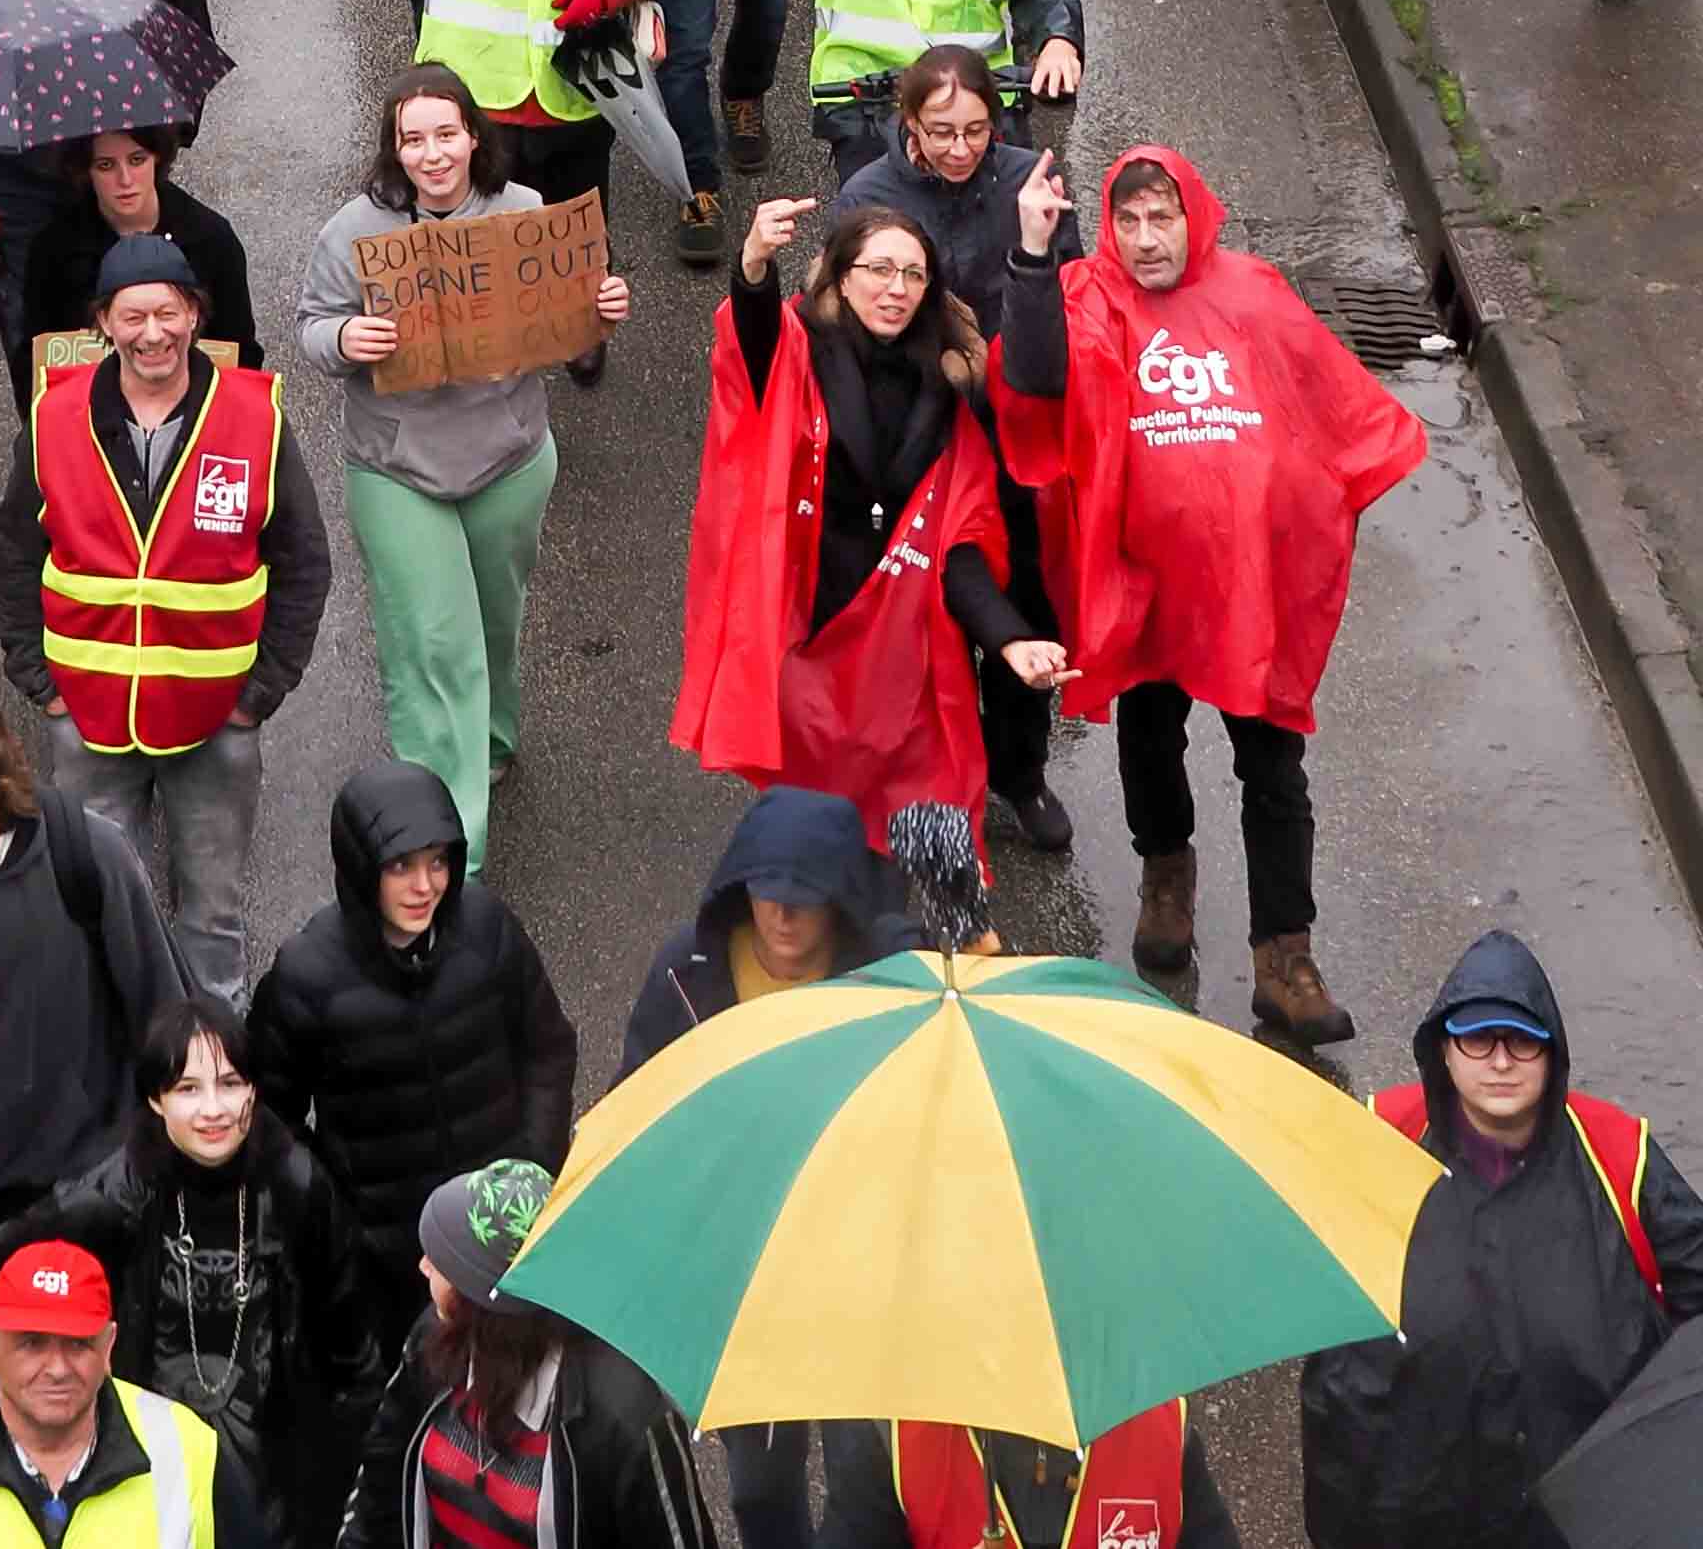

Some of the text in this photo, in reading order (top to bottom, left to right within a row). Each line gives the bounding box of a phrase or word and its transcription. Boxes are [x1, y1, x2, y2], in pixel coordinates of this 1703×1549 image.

[355, 200, 594, 277] BORNE OUT
[365, 242, 597, 316] BORNE OUT
[396, 295, 490, 343] ORNE
[1137, 350, 1234, 404] cgt
[1144, 422, 1237, 447] Territoriale
[1190, 405, 1263, 427] Publique
[200, 480, 245, 516] cgt
[32, 1270, 70, 1296] cgt
